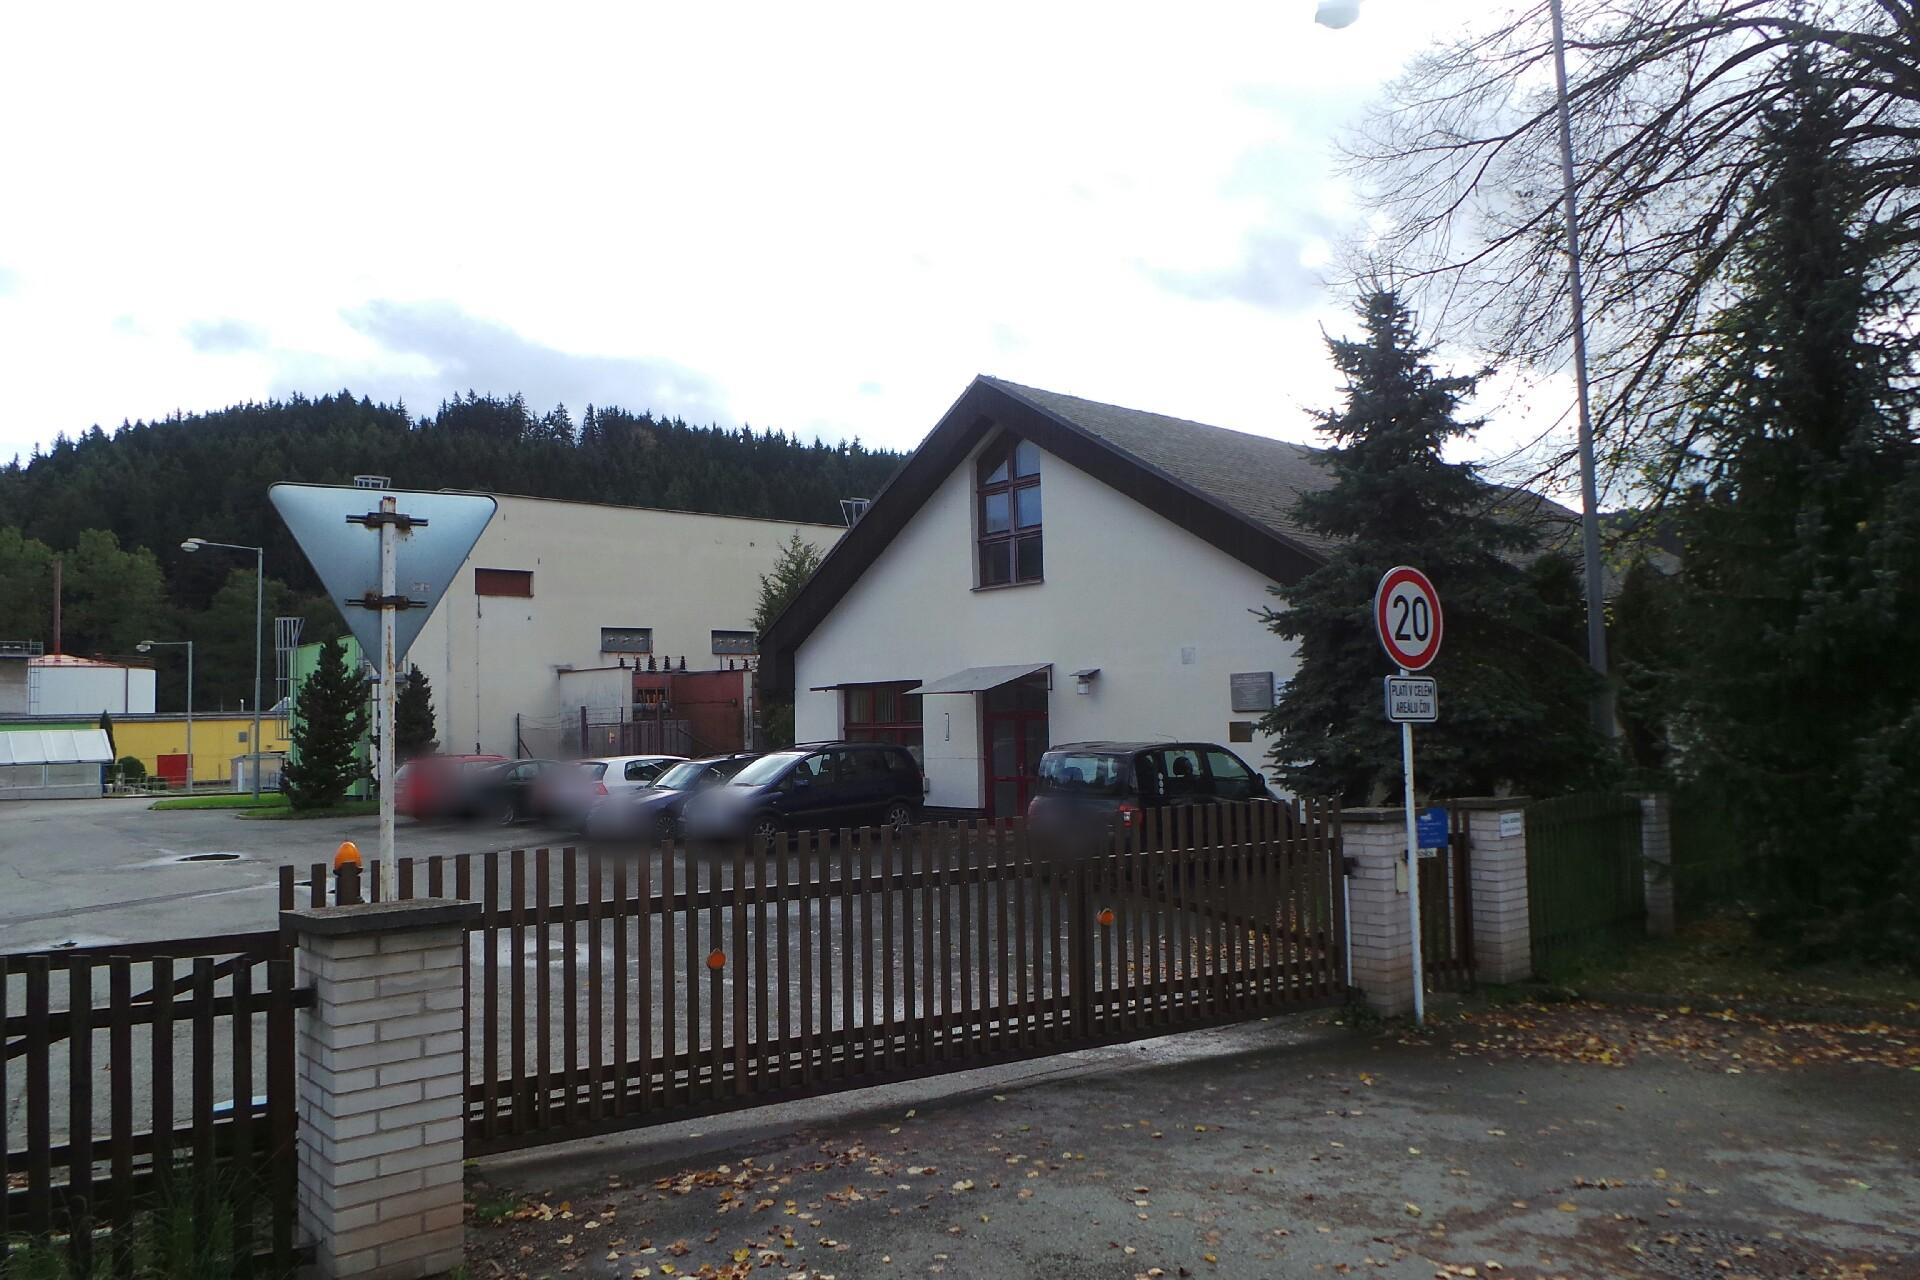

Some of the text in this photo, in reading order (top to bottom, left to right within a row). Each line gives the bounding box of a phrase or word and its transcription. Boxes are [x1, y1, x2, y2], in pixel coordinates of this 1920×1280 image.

[1393, 595, 1429, 641] 20
[1392, 683, 1407, 696] PLATÍ
[1408, 684, 1413, 696] V
